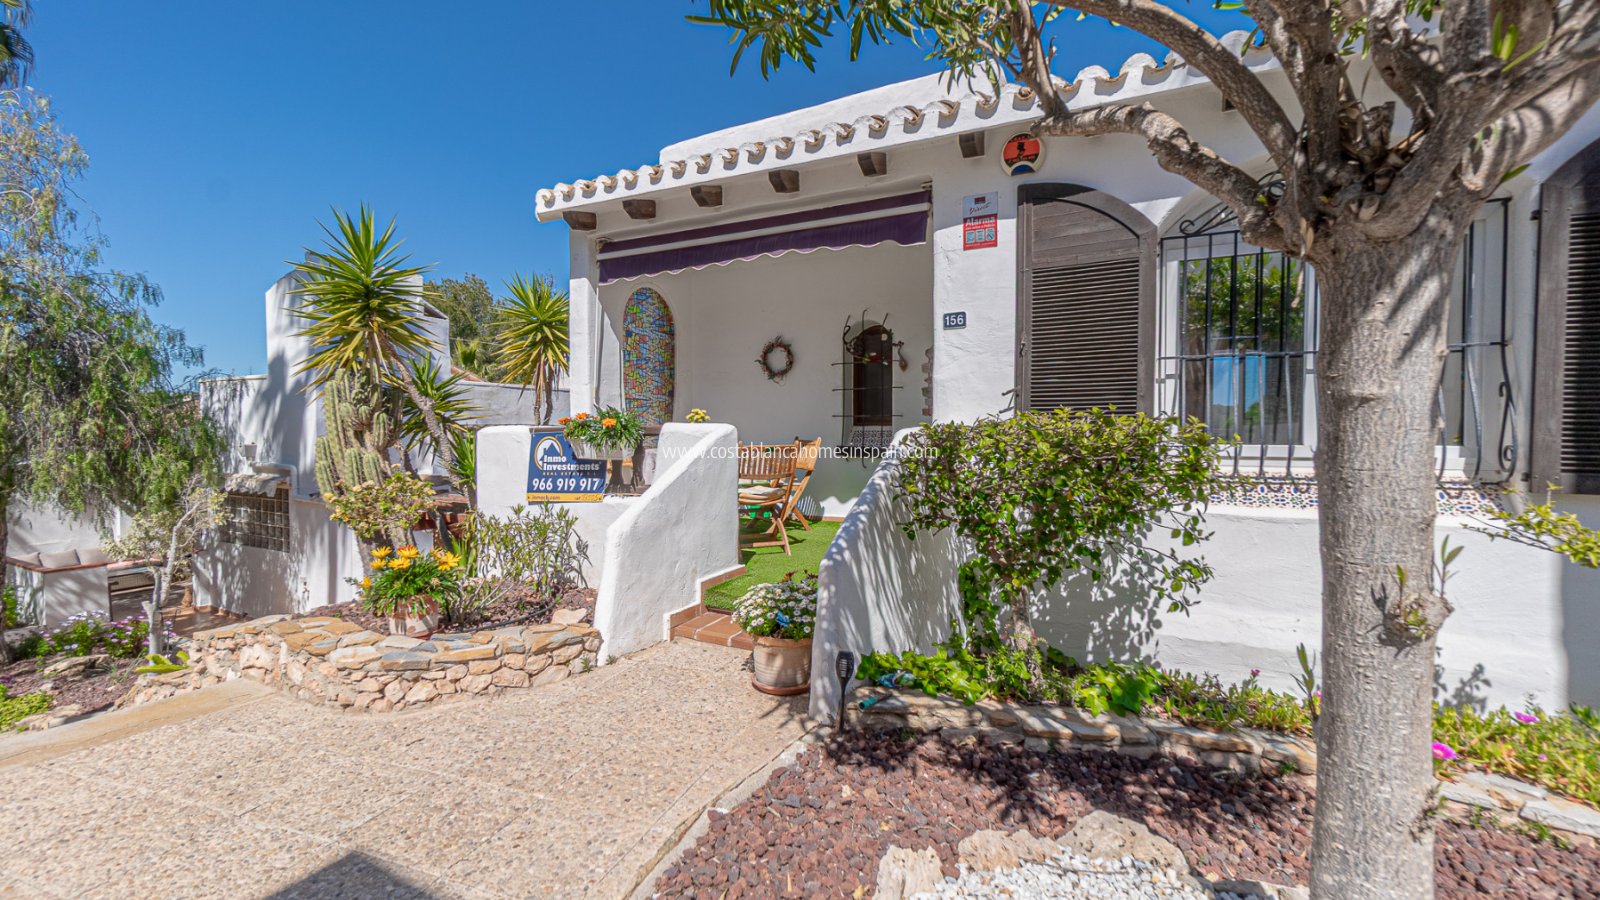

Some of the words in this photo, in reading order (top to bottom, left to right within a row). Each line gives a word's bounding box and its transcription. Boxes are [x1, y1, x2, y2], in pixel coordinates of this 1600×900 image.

[966, 216, 996, 227] Alarma
[944, 314, 965, 326] 156
[543, 454, 567, 463] Inmo
[543, 462, 600, 471] Investments
[532, 477, 553, 491] 966
[556, 477, 576, 491] 919
[579, 477, 601, 491] 917
